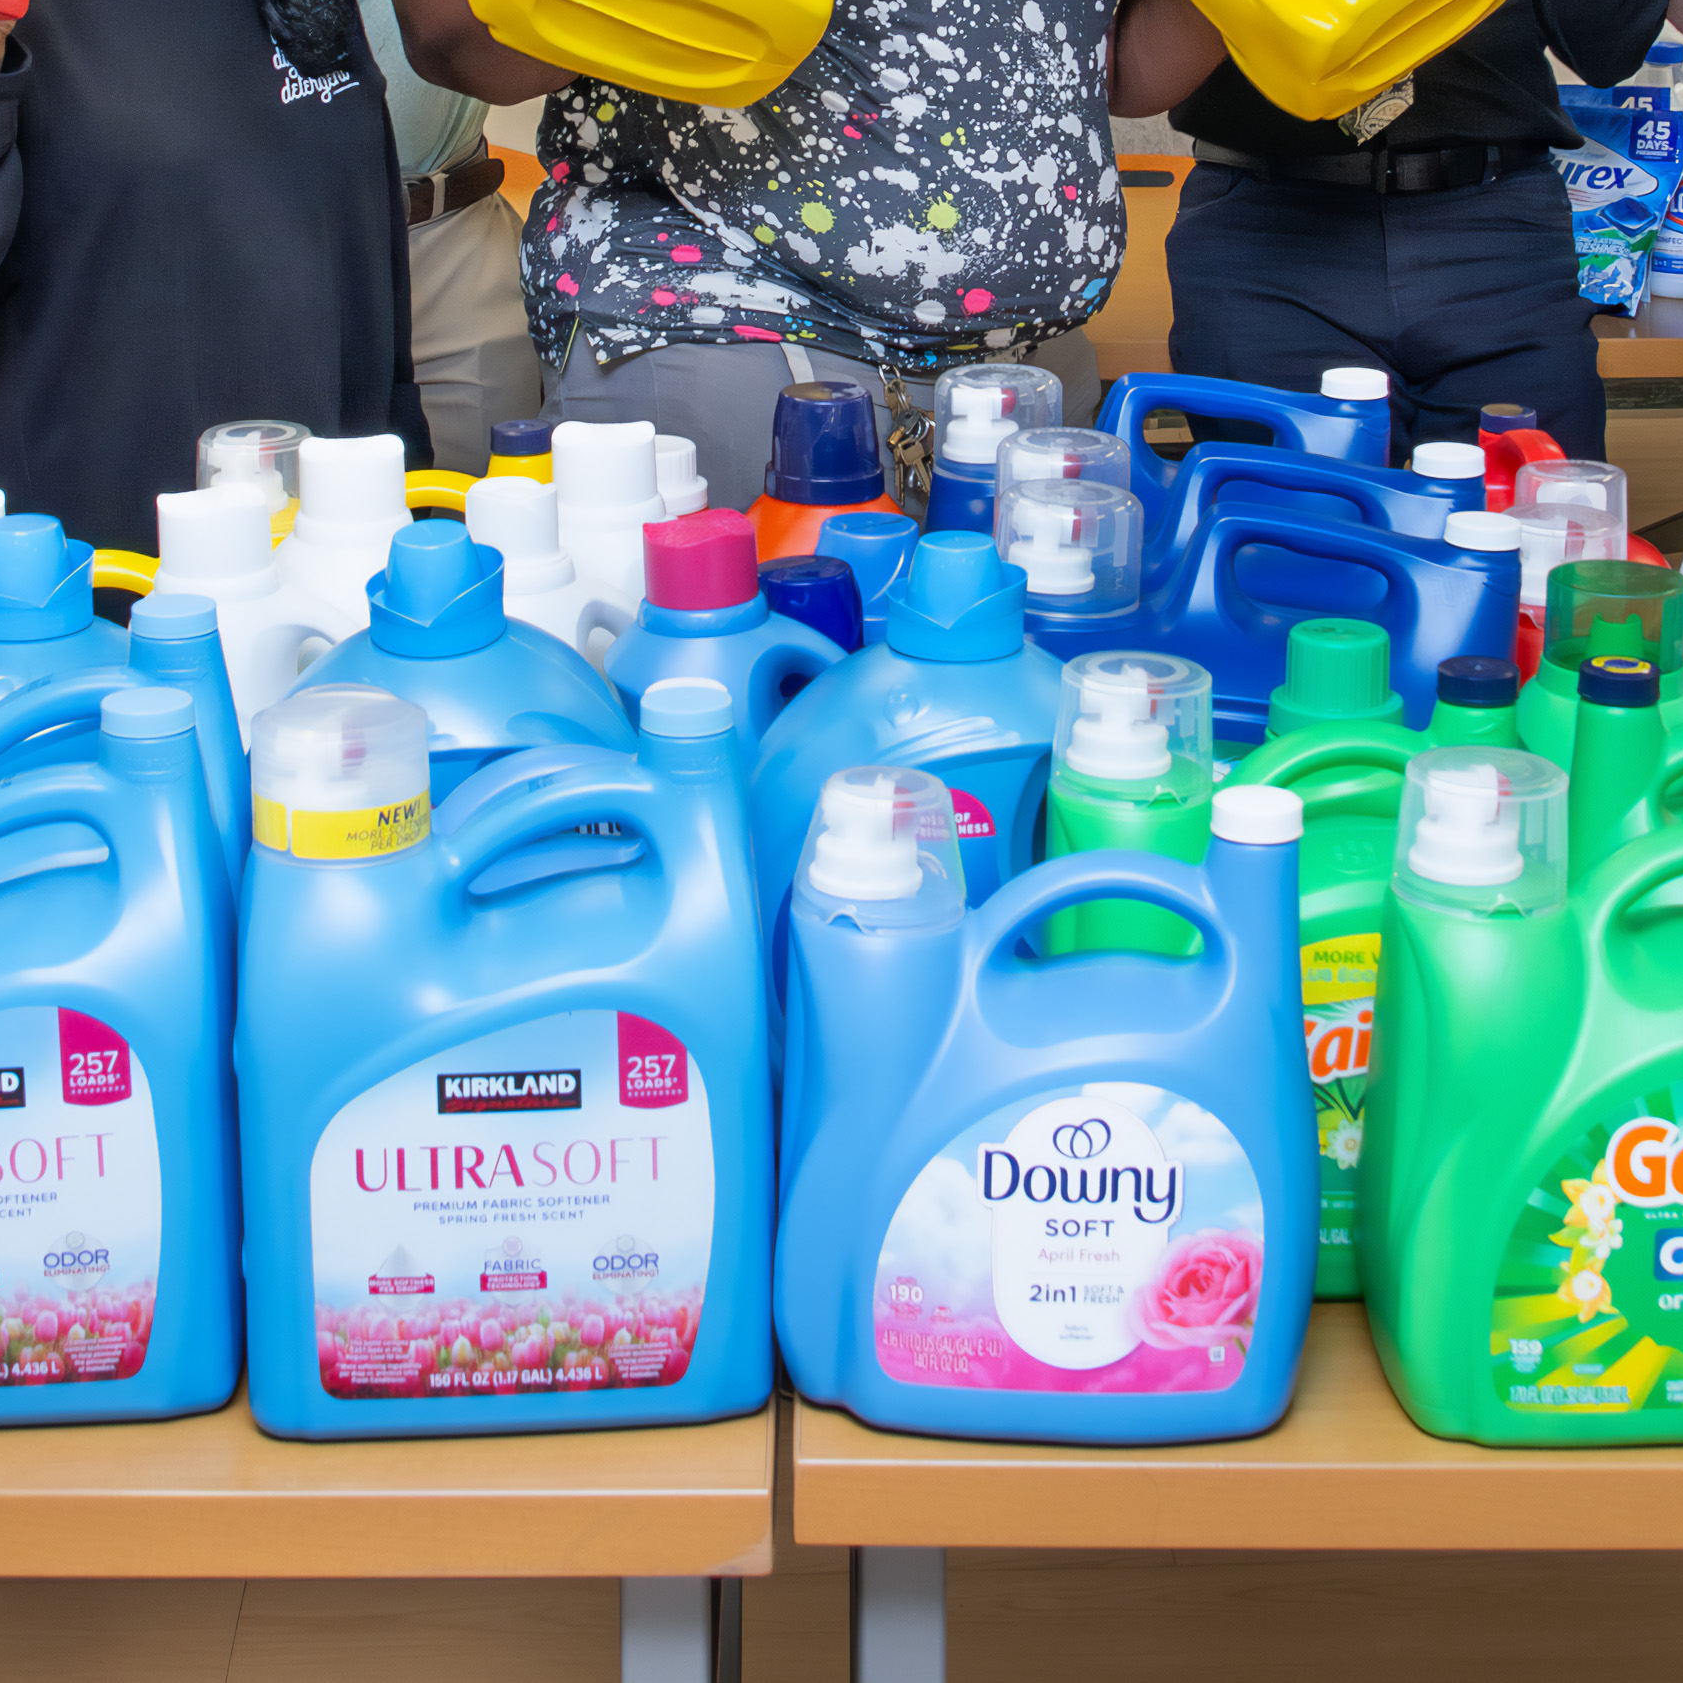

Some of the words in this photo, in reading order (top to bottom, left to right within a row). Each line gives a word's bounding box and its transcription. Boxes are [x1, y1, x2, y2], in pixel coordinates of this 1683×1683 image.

[1637, 120, 1671, 140] 45
[377, 799, 421, 827] NEW!
[347, 828, 384, 843] MORE
[1314, 949, 1365, 964] MORE
[1304, 1009, 1373, 1077] ai
[70, 1050, 118, 1076] 257
[627, 1054, 676, 1079] 257
[445, 1074, 576, 1099] KIRKLAND
[983, 1149, 1177, 1224] Downy
[414, 1201, 478, 1212] PREMIUM
[483, 1199, 532, 1210] FABRIC
[537, 1195, 610, 1207] SOFTENER
[439, 1215, 487, 1225] SPRING
[494, 1213, 537, 1223] FRESH
[542, 1211, 585, 1221] SCENT
[1045, 1219, 1115, 1238] SOFT
[43, 1248, 109, 1267] ODOR
[593, 1253, 659, 1271] ODOR
[1038, 1249, 1074, 1263] April
[1079, 1248, 1120, 1262] Fresh
[484, 1259, 541, 1273] FABRIC
[889, 1284, 924, 1304] 190
[1083, 1285, 1115, 1294] SOFT
[1083, 1294, 1120, 1303] FRESH
[52, 1361, 60, 1374] L
[454, 1372, 469, 1386] FL
[472, 1372, 490, 1386] OZ
[595, 1366, 603, 1380] L
